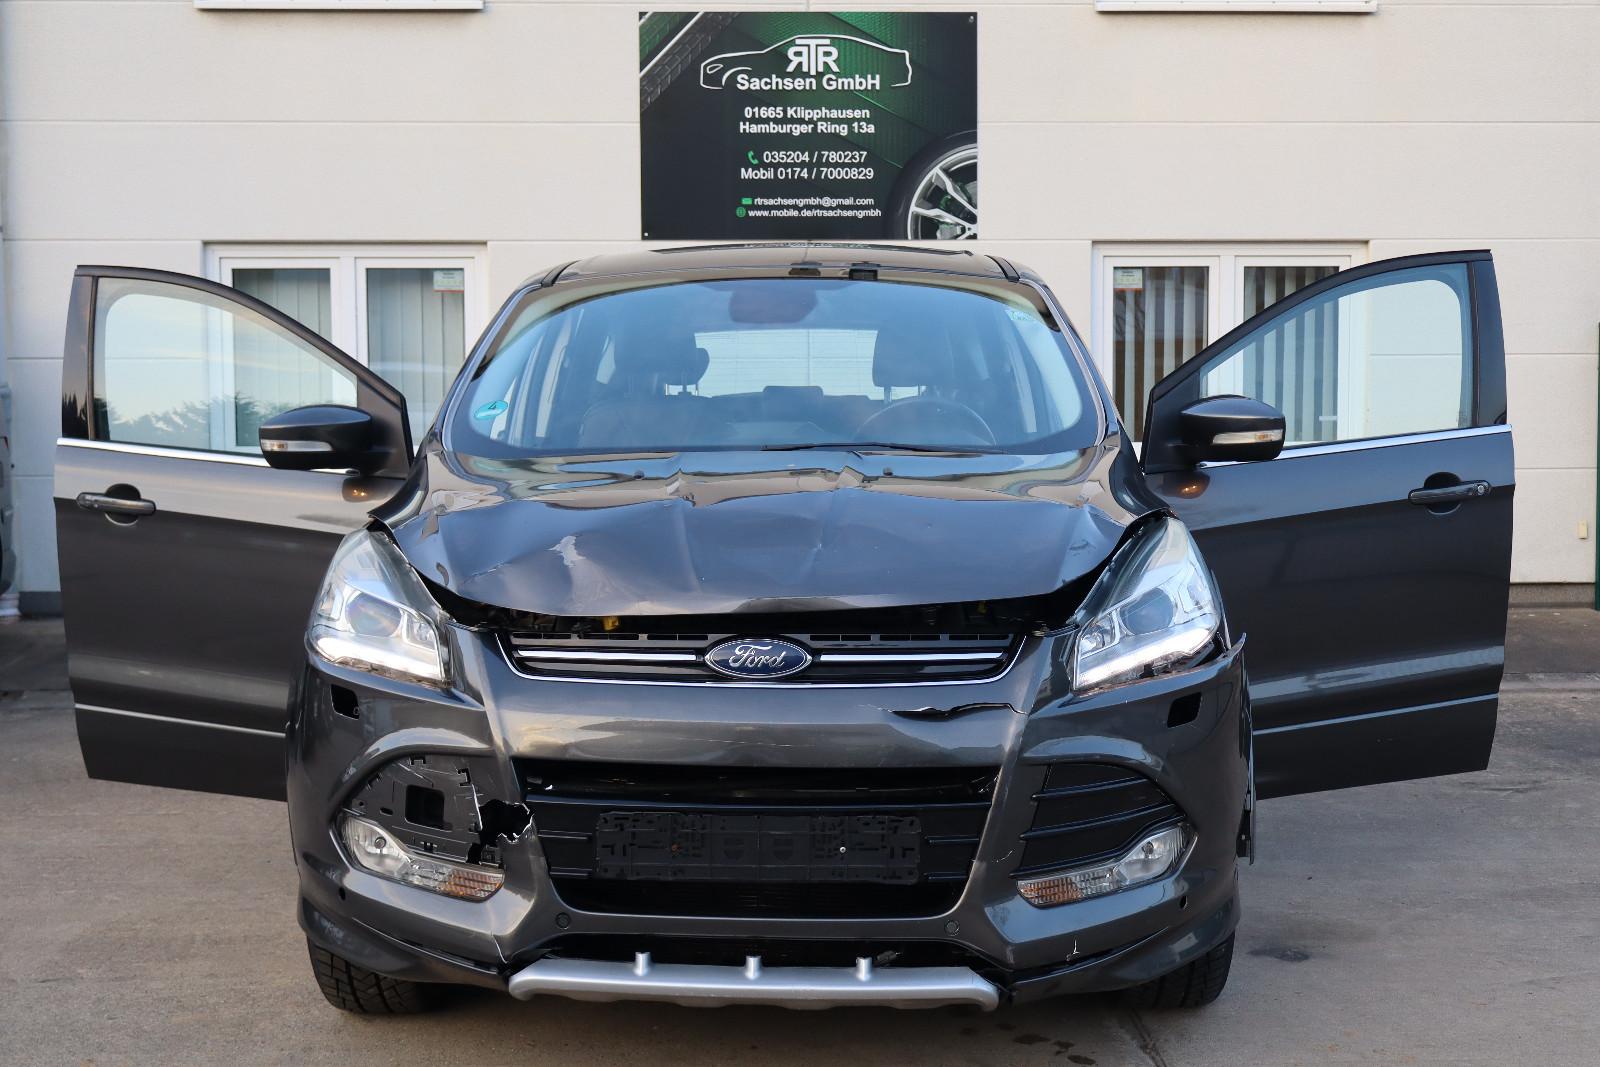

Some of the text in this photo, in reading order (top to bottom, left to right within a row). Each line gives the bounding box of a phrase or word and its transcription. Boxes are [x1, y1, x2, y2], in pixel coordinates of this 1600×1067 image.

[736, 74, 881, 90] Sachsen GmbH
[744, 107, 870, 121] 01665 Klipphausen
[739, 122, 875, 135] Hamburger Ring 13a
[763, 151, 810, 163] 035204
[821, 151, 868, 163] 780237
[740, 167, 774, 179] Mobil
[777, 167, 808, 179] 0174
[820, 167, 874, 179] 7000829
[754, 197, 874, 207] rtrsachsengmbh@gmail.com
[748, 208, 882, 218] www.mobile.de/rtrsachsengmbh
[728, 644, 787, 668] Ford
